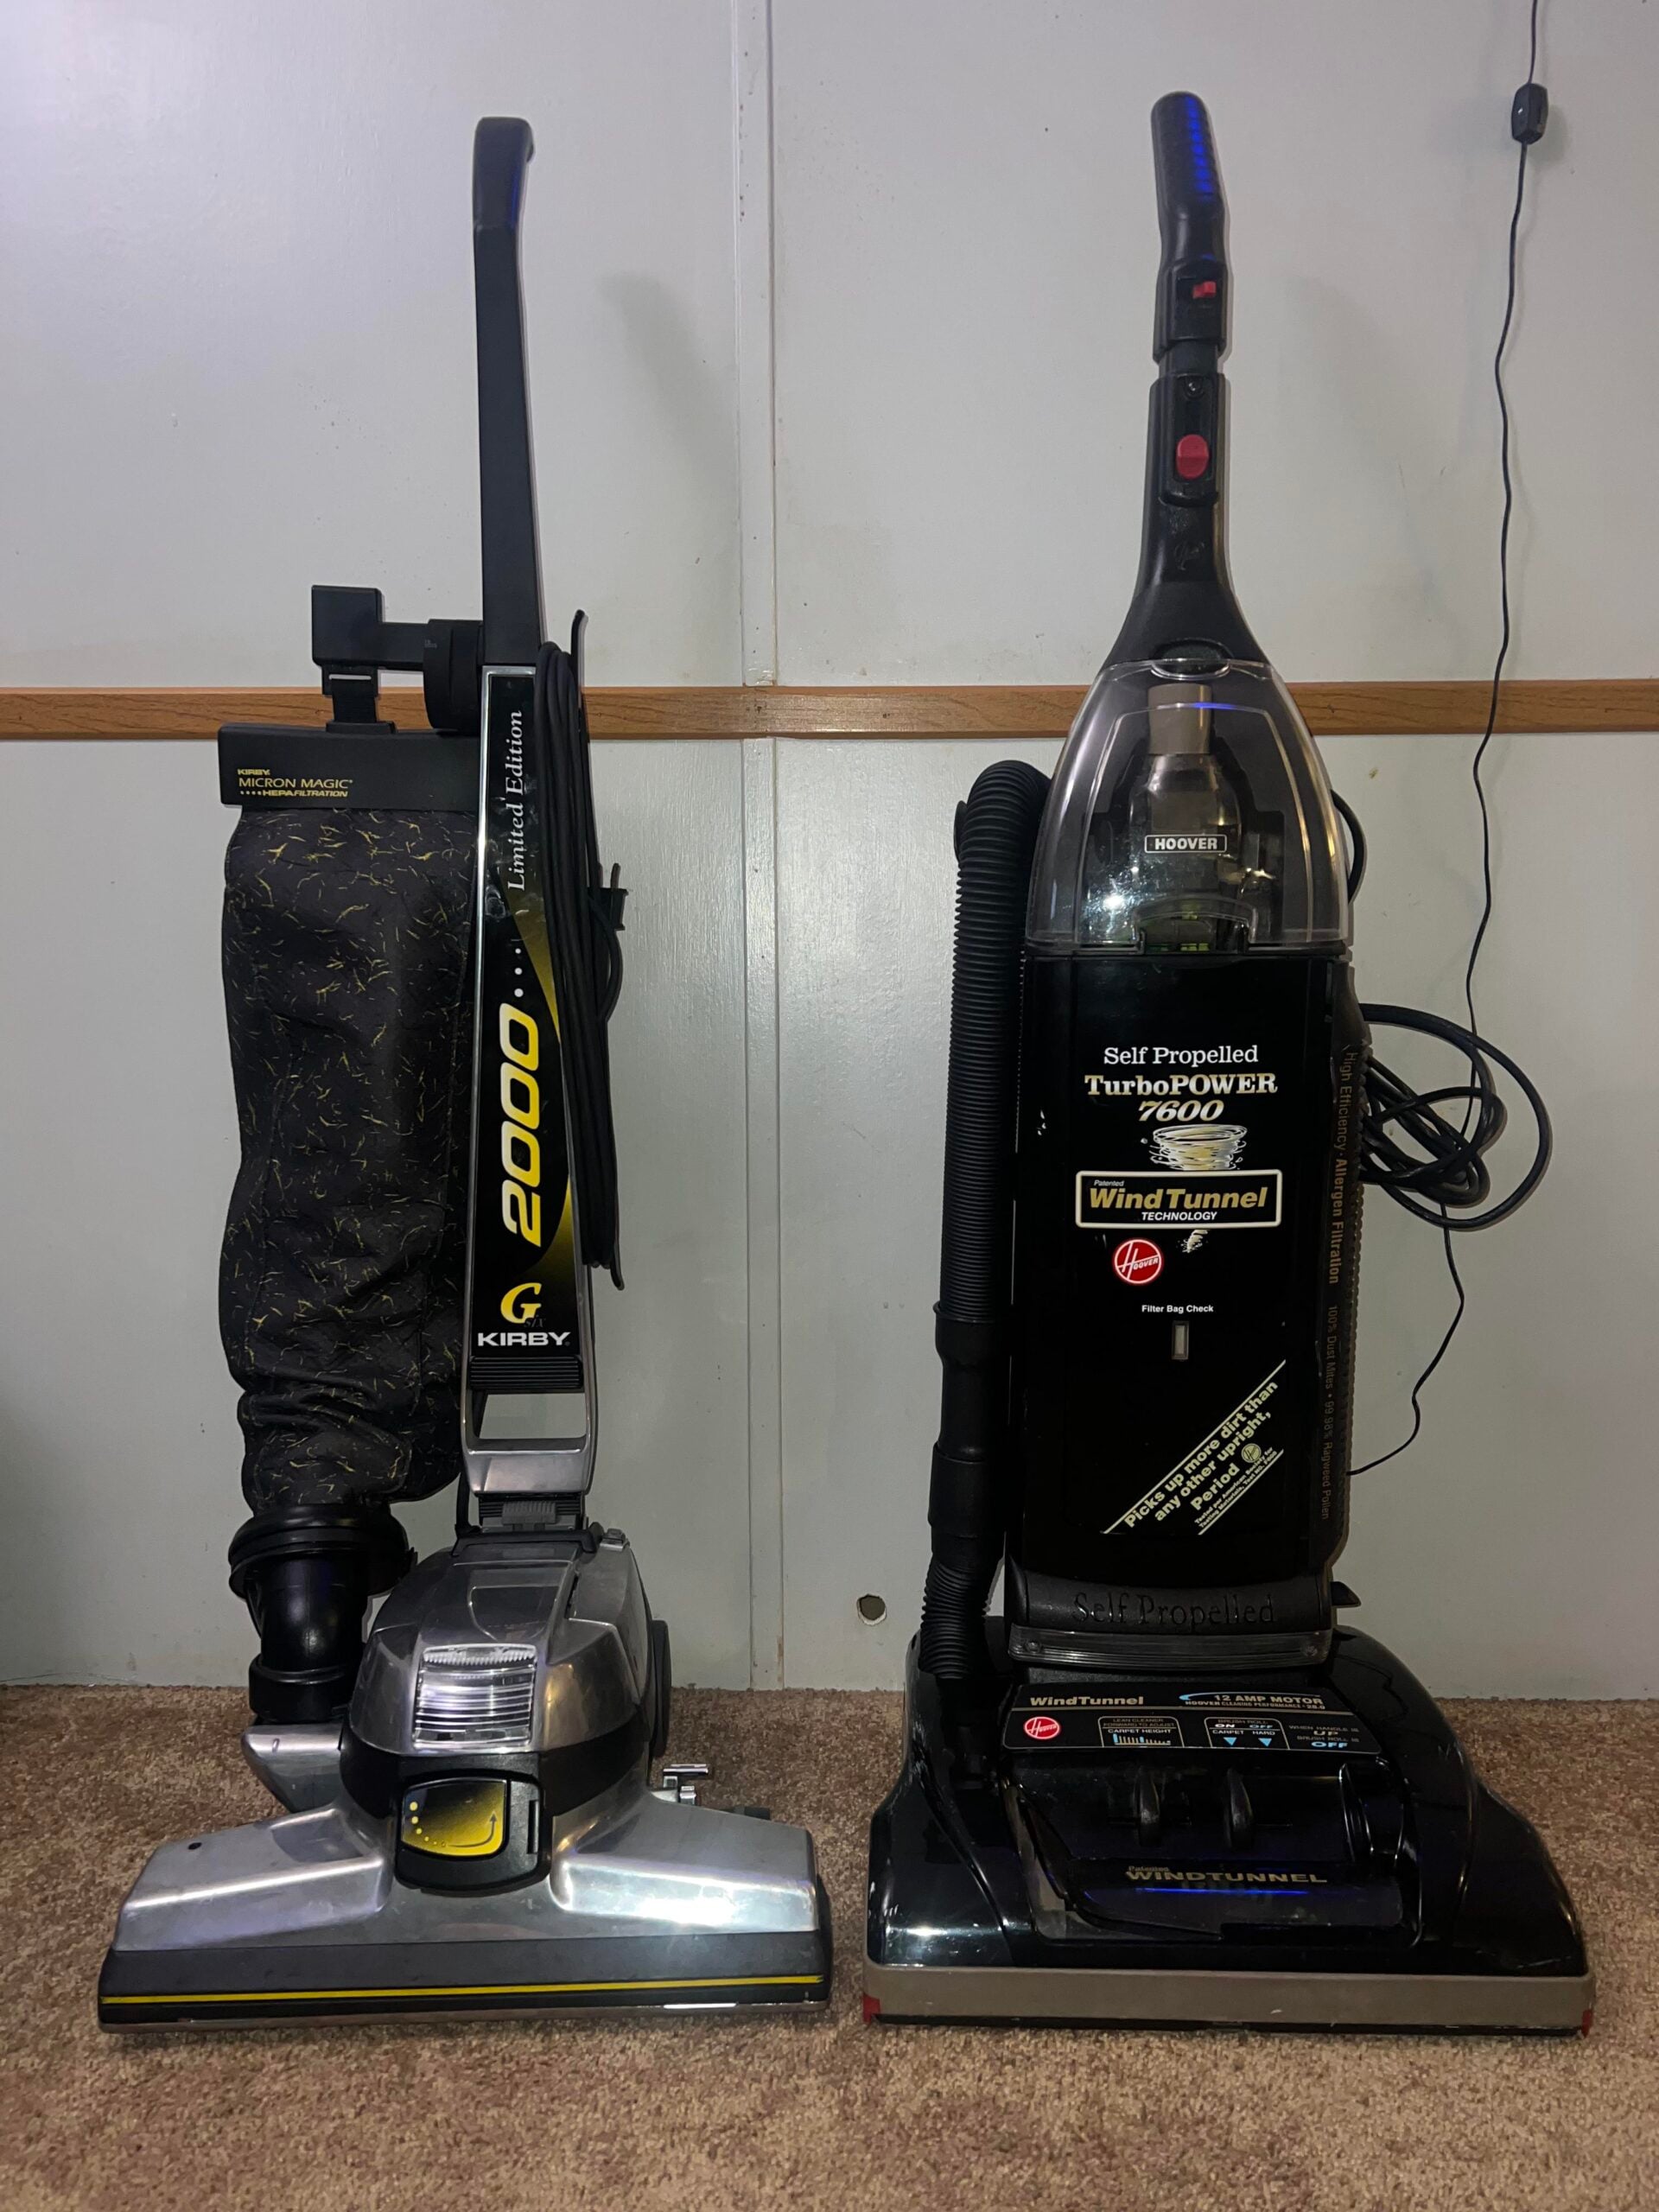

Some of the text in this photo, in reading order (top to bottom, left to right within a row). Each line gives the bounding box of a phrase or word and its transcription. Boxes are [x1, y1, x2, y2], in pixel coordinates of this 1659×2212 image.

[238, 778, 296, 788] MICRON
[505, 710, 525, 890] Limited Edition
[1154, 837, 1217, 850] HOOVER
[1103, 1045, 1259, 1067] Self Propelled
[1084, 1072, 1278, 1096] TurboPOWER
[1139, 1100, 1224, 1122] 7600
[499, 1002, 542, 1247] 2000
[1328, 1052, 1357, 1285] High Efficiency Allergen Filtration
[1141, 1211, 1217, 1221] TECHNOLOGY
[500, 1281, 543, 1324] G
[1166, 1305, 1185, 1314] Bag
[477, 1332, 570, 1346] KIRBY
[1325, 1336, 1337, 1359] Dust
[1325, 1363, 1336, 1389] Mites
[1123, 1491, 1165, 1528] Picks
[1165, 1474, 1185, 1495] up
[1185, 1440, 1220, 1474] more
[1220, 1413, 1247, 1440] dirt
[1245, 1382, 1278, 1414] than
[1154, 1495, 1183, 1522] any
[1181, 1460, 1217, 1497] other
[1219, 1411, 1272, 1463] upright,
[1320, 1441, 1333, 1487] Ragweed
[1190, 1463, 1240, 1511] Period
[1194, 1506, 1214, 1524] Tested
[1222, 1474, 1247, 1500] American
[1320, 1490, 1332, 1520] Pollen
[1072, 1592, 1274, 1634] Self Propelled
[1029, 1696, 1144, 1706] WindTunnel
[1235, 1694, 1266, 1703] AMP
[1270, 1695, 1324, 1705] MOTOR
[1124, 1871, 1328, 1884] WINDTUNNEL
